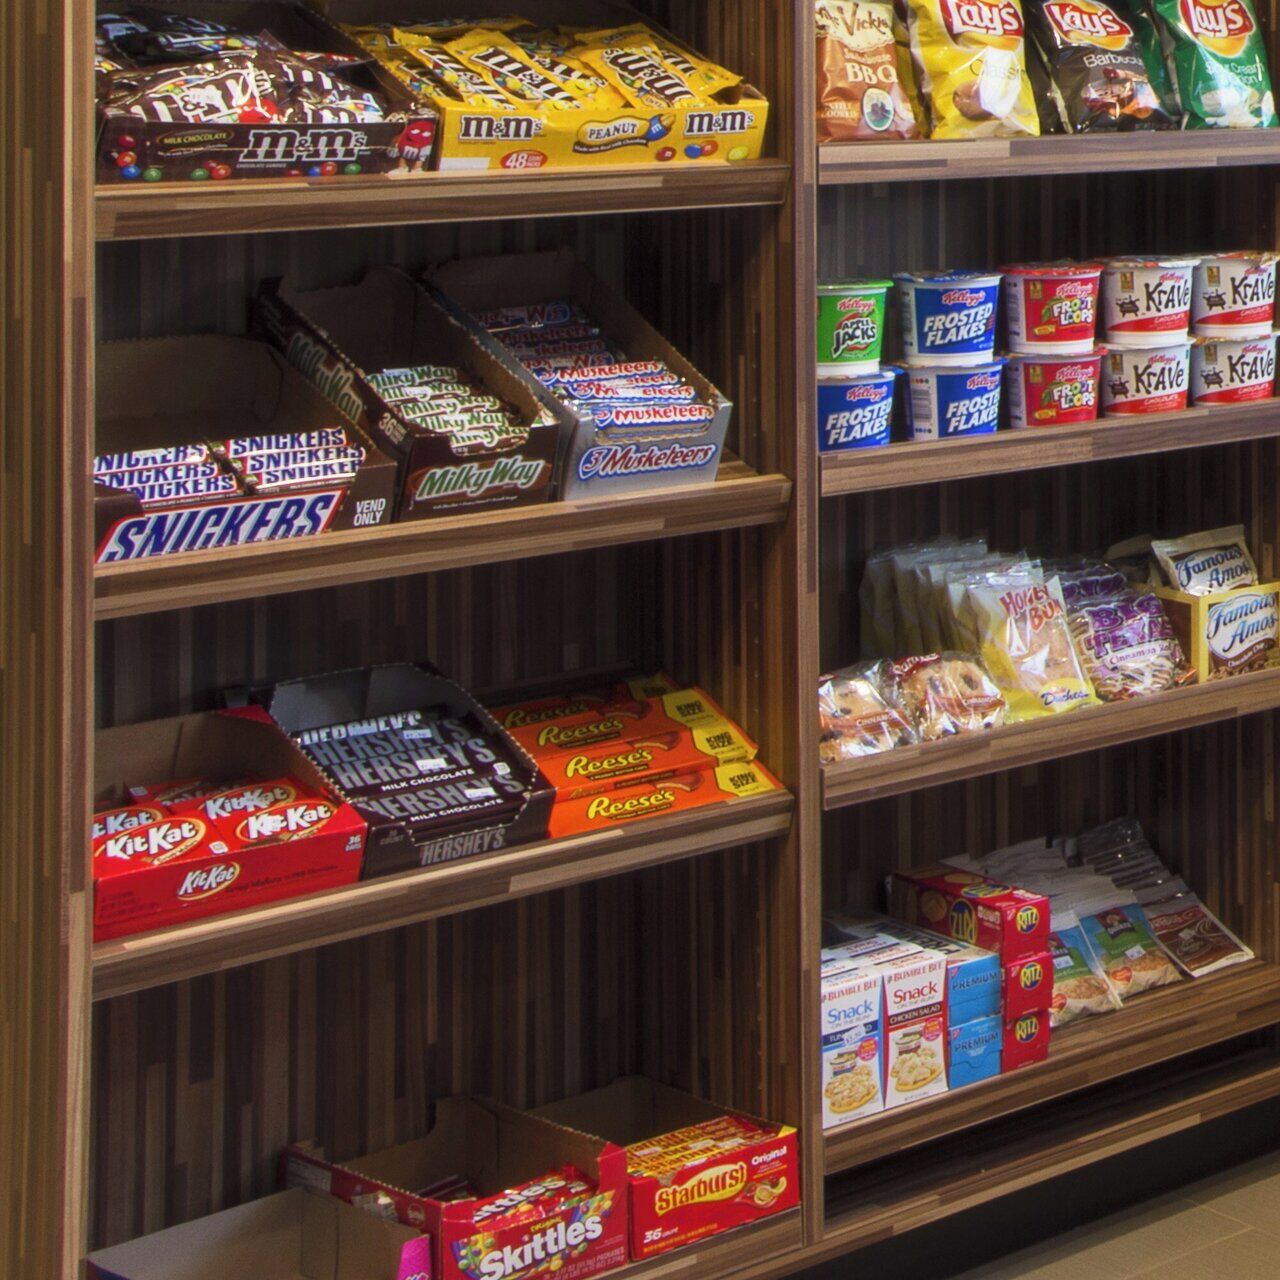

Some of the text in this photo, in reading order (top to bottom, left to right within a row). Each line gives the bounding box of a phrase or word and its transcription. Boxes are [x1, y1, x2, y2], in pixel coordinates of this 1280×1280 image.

[1050, 3, 1120, 38] Lay's
[845, 62, 899, 85] BBQ
[163, 132, 228, 146] MILK CHOCOLATE
[588, 121, 638, 141] PEANUT
[505, 152, 527, 168] 48
[924, 303, 993, 333] FROSTED
[1052, 296, 1093, 317] FROOT
[1060, 310, 1093, 326] LOOPS
[832, 324, 877, 359] JACKS
[925, 320, 987, 347] FLAKES
[558, 361, 662, 381] Musketeers
[1052, 379, 1094, 400] FROOT
[1060, 393, 1095, 411] LOOPS
[614, 405, 715, 423] Musketeers
[826, 399, 893, 431] FROSTED
[948, 405, 999, 433] FLAKES
[233, 428, 346, 456] SNICKERS
[827, 417, 888, 446] FLAKES
[600, 444, 715, 472] Musketeers
[353, 511, 385, 526] ONLY
[355, 498, 387, 514] VEND
[100, 494, 336, 562] SNICKERS
[1175, 544, 1242, 588] Famous
[1209, 561, 1250, 590] Amos
[1029, 598, 1064, 634] BUN
[1085, 593, 1164, 631] BIG
[1207, 593, 1277, 640] Famous
[1223, 617, 1277, 653] Amos
[537, 718, 624, 747] Reese's
[706, 731, 733, 742] KING
[331, 738, 496, 790] HERSHEY'S
[566, 748, 653, 778] Reese's
[382, 768, 475, 792] MILK CHOCOLATE
[729, 771, 756, 783] KING
[410, 798, 504, 822] MILK CHOCOLATE
[587, 789, 676, 820] Reese's
[287, 803, 332, 833] Kat
[105, 821, 198, 860] Kit Kat
[420, 827, 506, 865] HERSHEY'S
[178, 870, 207, 896] Kit
[203, 865, 235, 891] Kat
[1016, 909, 1039, 932] RITZ
[893, 962, 942, 982] BUMBLE BEE
[952, 971, 999, 992] PREMIUM
[1021, 966, 1043, 989] RITZ
[827, 979, 878, 1002] BUMBLE BEE
[893, 980, 939, 1005] Snack
[827, 999, 874, 1024] Snack
[889, 1004, 941, 1024] CHICKEN SALAD
[954, 1032, 999, 1053] PREMIUM
[1015, 1019, 1038, 1042] RITZ
[750, 1145, 788, 1166] Original
[656, 1162, 748, 1216] Starburst
[480, 1215, 603, 1280] Skittles
[643, 1227, 663, 1244] 36
